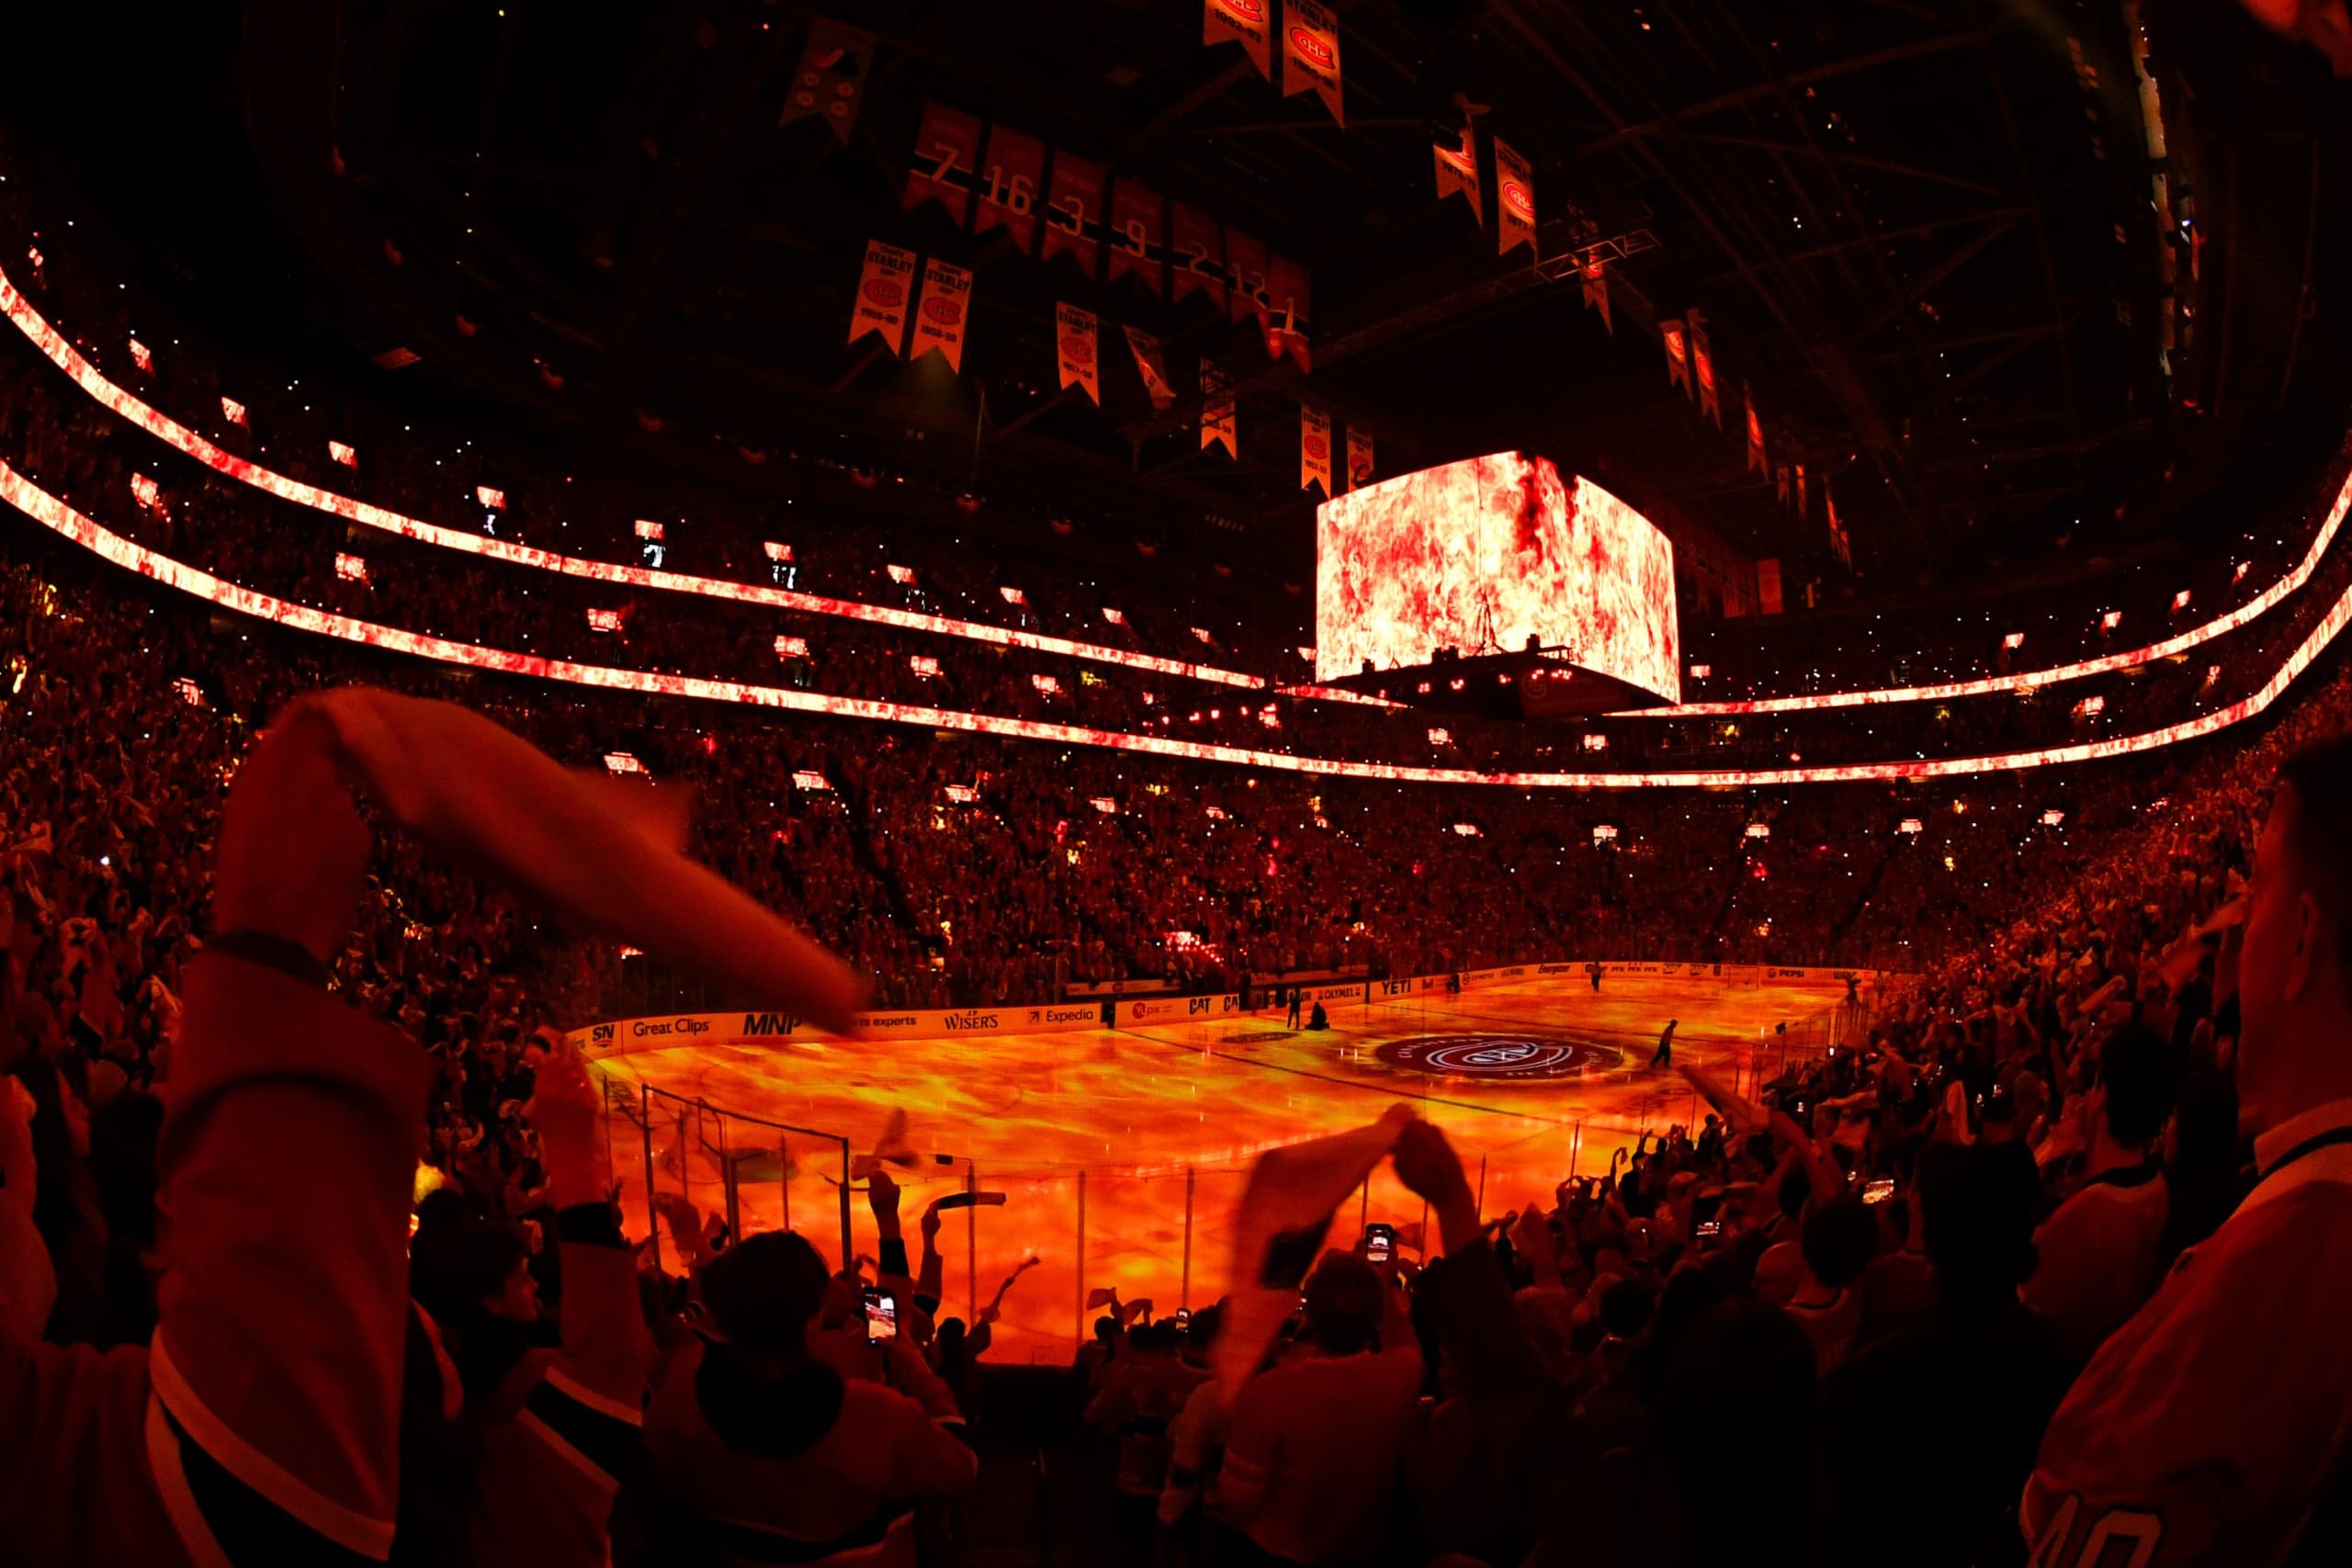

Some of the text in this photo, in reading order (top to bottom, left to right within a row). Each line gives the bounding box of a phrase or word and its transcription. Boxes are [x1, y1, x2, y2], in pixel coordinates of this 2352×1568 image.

[931, 141, 959, 182] 7
[986, 164, 1034, 217] 16
[1061, 195, 1085, 237] 3
[1126, 219, 1147, 258] 9
[867, 252, 912, 272] STANLEY
[926, 269, 970, 291] STANLEY
[1283, 297, 1297, 335] 1
[1779, 969, 1805, 977] PEPSI
[1324, 987, 1353, 1000] OLYMEL
[1382, 977, 1411, 995] YETI
[1189, 998, 1211, 1015] CAT
[1223, 994, 1240, 1012] CA
[873, 1017, 916, 1028] experts
[1046, 1010, 1093, 1022] Expedia
[593, 1024, 615, 1042] SN
[634, 1019, 709, 1037] Great Clips
